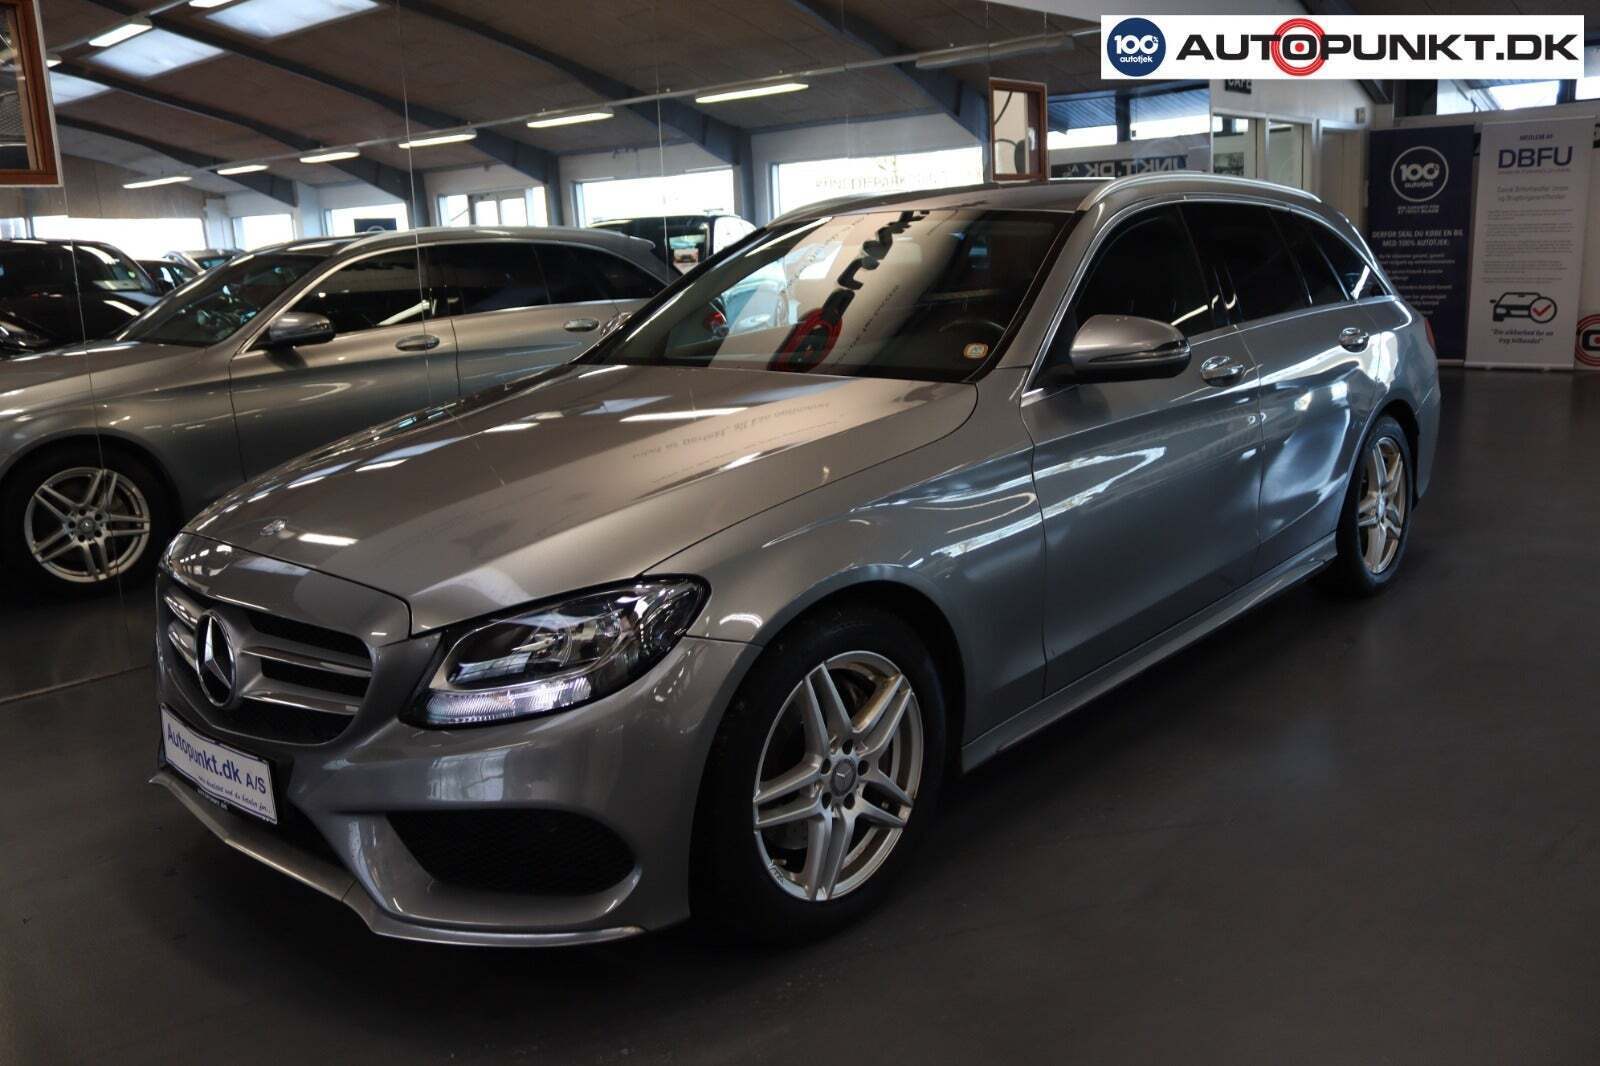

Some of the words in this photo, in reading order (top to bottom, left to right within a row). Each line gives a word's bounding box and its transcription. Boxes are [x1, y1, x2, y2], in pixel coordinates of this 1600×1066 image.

[1498, 146, 1573, 168] DBFU
[167, 723, 242, 784] Autopunkt.dk
[246, 773, 266, 795] A/S
